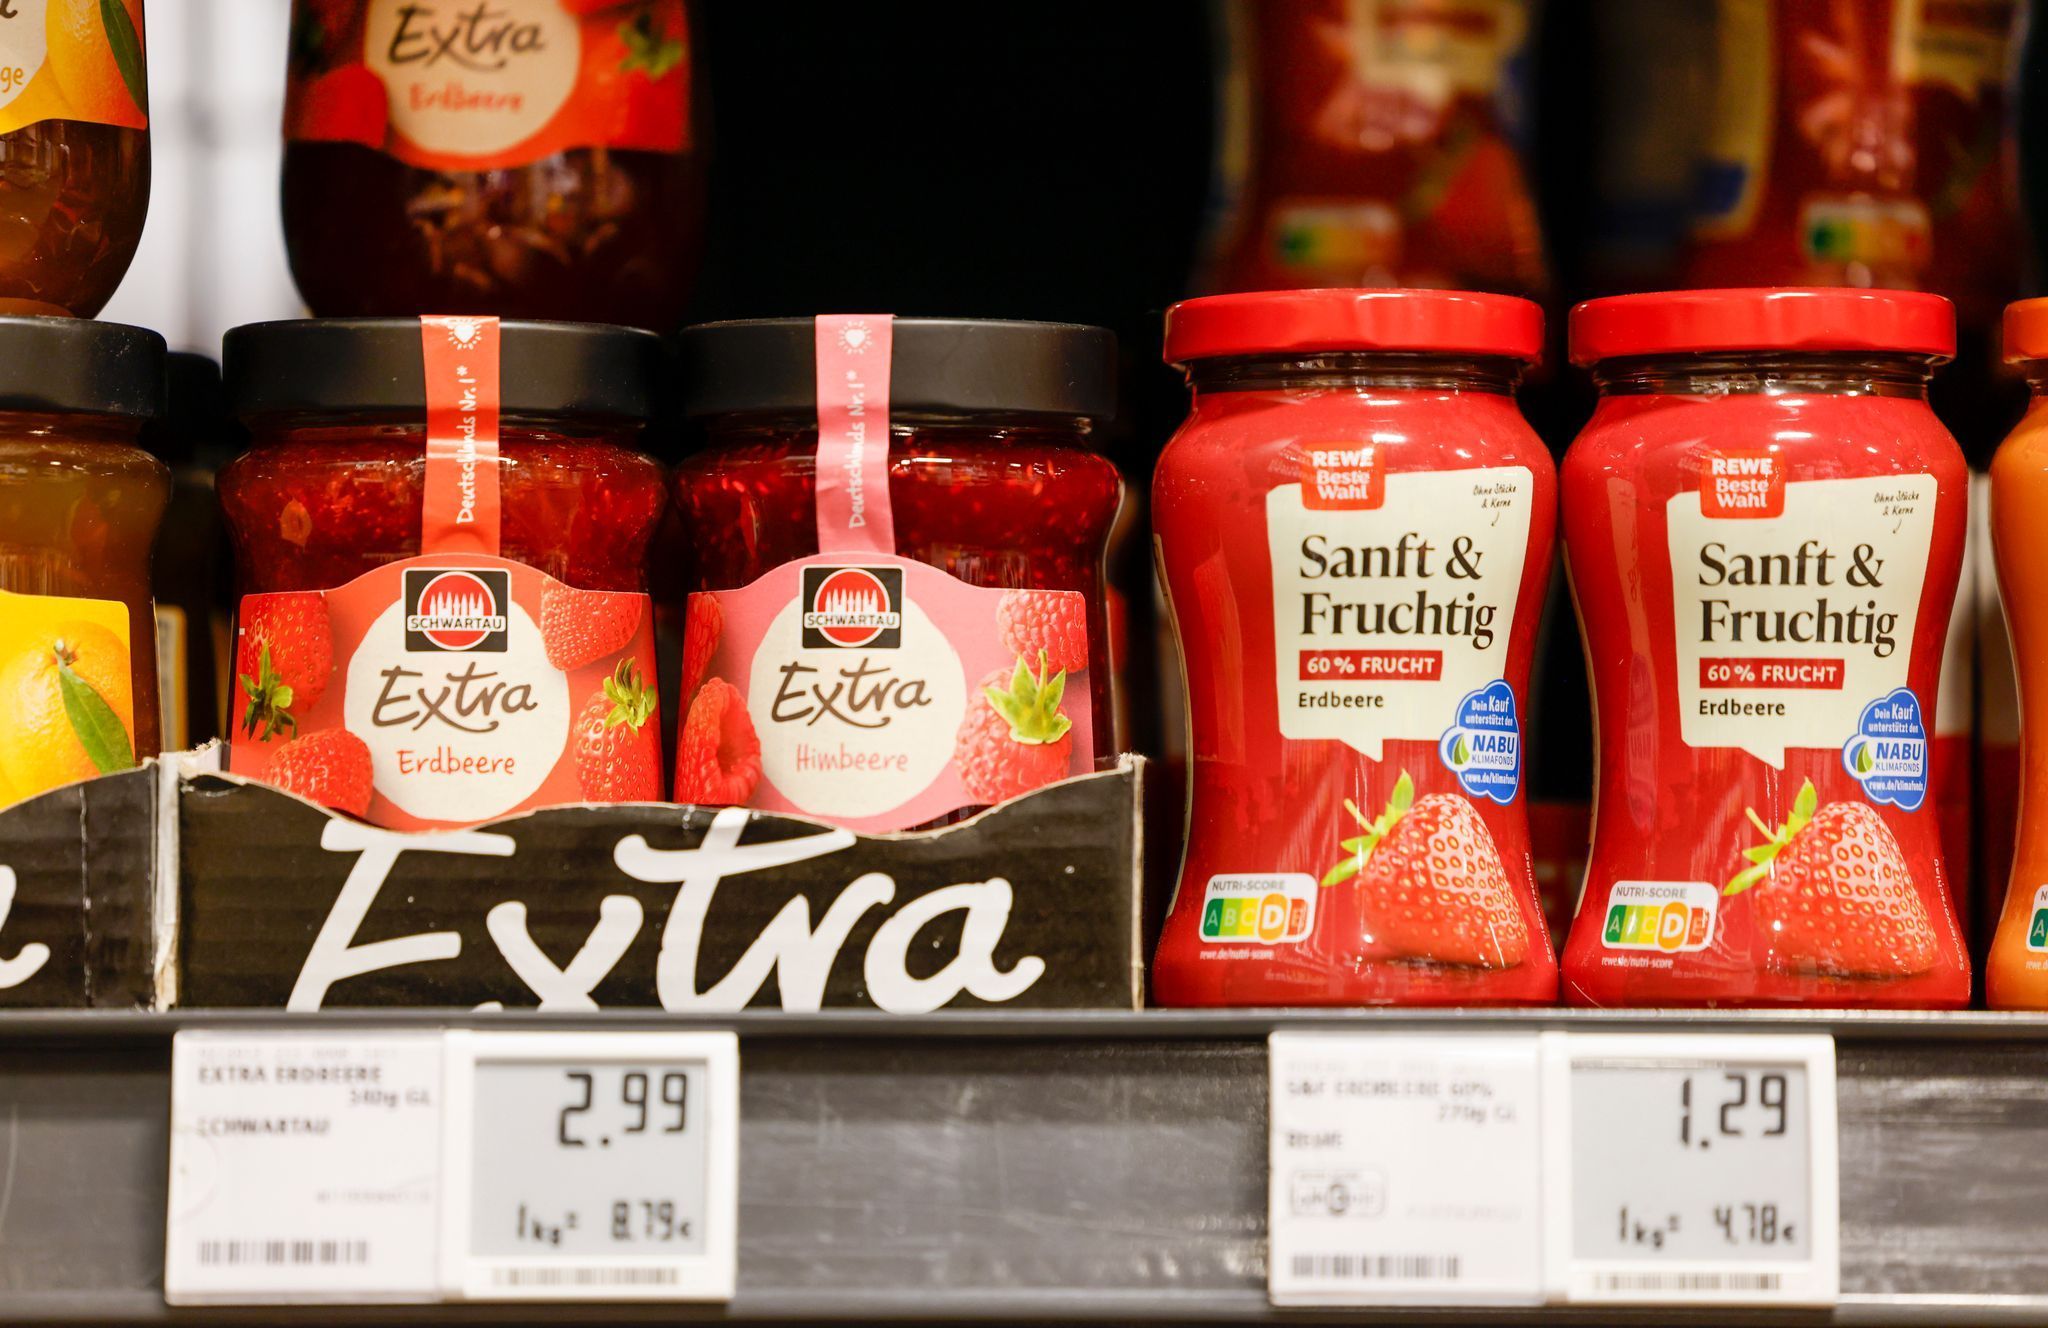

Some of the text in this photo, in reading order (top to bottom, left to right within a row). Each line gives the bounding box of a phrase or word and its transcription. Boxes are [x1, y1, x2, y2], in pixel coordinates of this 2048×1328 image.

[387, 1, 546, 73] Extra
[1311, 450, 1374, 468] REWE
[1711, 457, 1774, 476] REWE
[456, 416, 476, 524] Deutschlands
[843, 422, 865, 529] Deutschlands
[1316, 469, 1370, 485] Beste
[1316, 484, 1368, 500] Wahl
[1716, 477, 1769, 493] Beste
[1716, 493, 1767, 508] Wahl
[1300, 532, 1483, 580] Sanft &
[1699, 540, 1885, 587] Sanft &
[409, 616, 504, 631] SCHWARTAU
[806, 613, 897, 628] SCHWARTAU
[1300, 590, 1497, 650] Fruchtig
[1700, 598, 1898, 658] Fruchtig
[1361, 657, 1435, 674] FRUCHT
[1762, 665, 1837, 682] FRUCHT
[371, 661, 538, 734] Extra
[770, 657, 932, 729] Extra
[1299, 692, 1384, 708] Erdbeere
[1471, 695, 1509, 713] Dein Kauf
[1699, 699, 1786, 716] Erdbeere
[1874, 703, 1914, 720] Dein Kauf
[1465, 713, 1503, 727] unterstützt
[1868, 719, 1908, 733] unterstützt
[1472, 734, 1515, 755] NABU
[1876, 743, 1921, 761] NABU
[396, 747, 515, 777] Erdbeere
[796, 745, 909, 772] Himbeere
[1471, 754, 1513, 766] KLIMAFONDS
[1875, 761, 1920, 772] KLIMAFONDS
[1211, 880, 1284, 892] NUTRI-SCORE
[1615, 886, 1688, 898] NUTRI-SCORE
[287, 808, 1045, 1014] Extra
[198, 1067, 266, 1082] EXTRA
[558, 1072, 687, 1147] 2.99
[1680, 1074, 1786, 1149] 1.29
